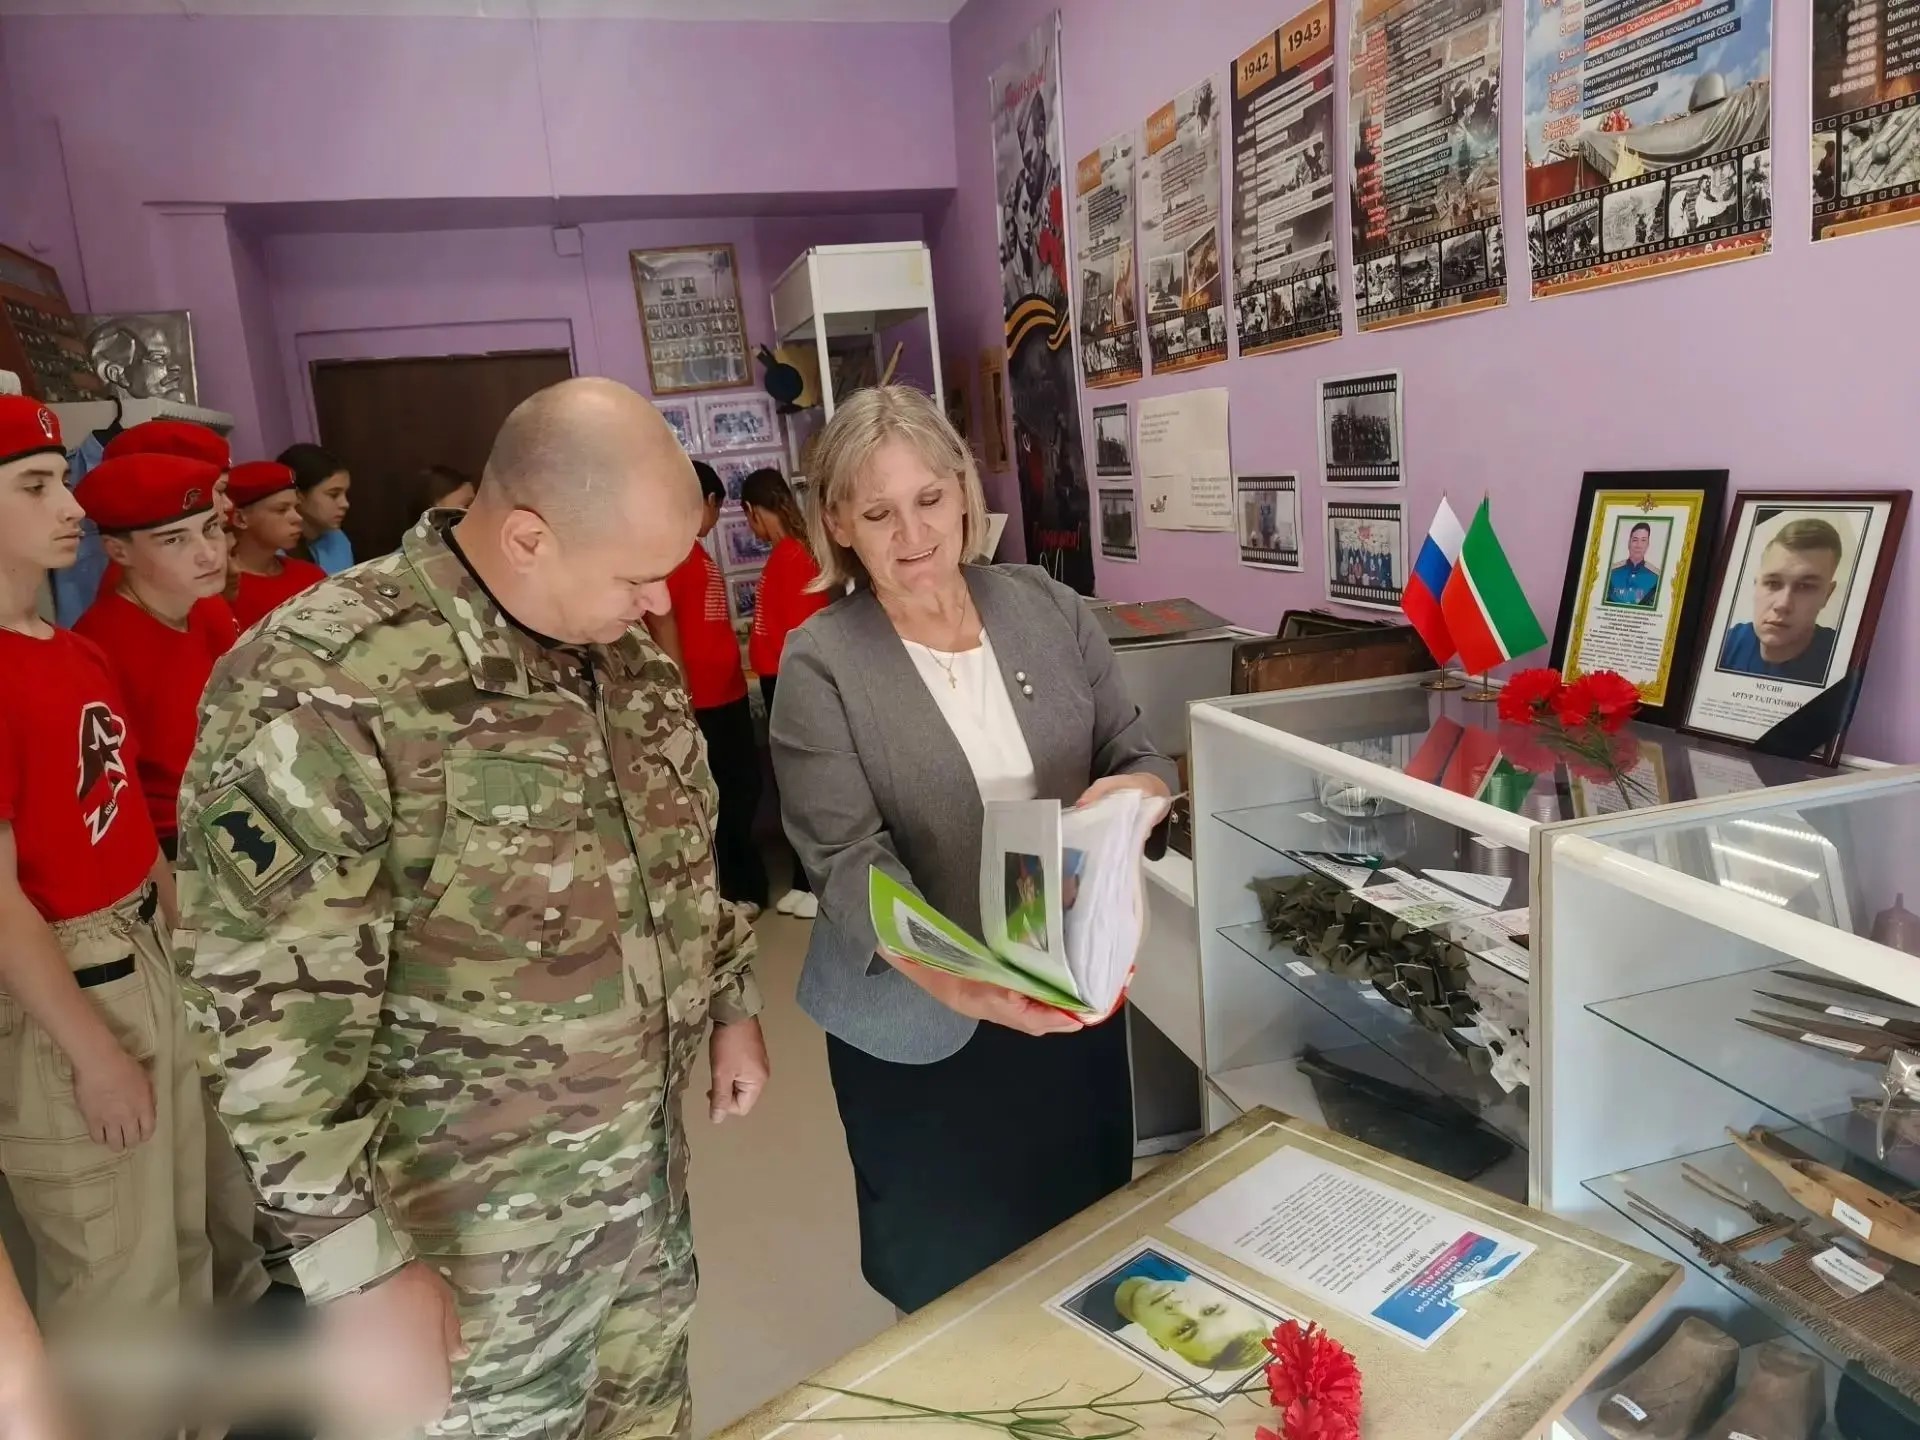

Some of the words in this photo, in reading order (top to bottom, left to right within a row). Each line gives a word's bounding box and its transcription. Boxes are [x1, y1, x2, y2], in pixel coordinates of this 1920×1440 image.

[1887, 22, 1910, 37] школ
[1888, 5, 1920, 22] библио
[1243, 52, 1268, 81] 1942
[1288, 18, 1321, 52] 1943
[1584, 53, 1602, 72] Парад
[1603, 42, 1628, 63] Победы
[1628, 42, 1636, 52] на
[1636, 27, 1665, 49] Красной
[1665, 16, 1694, 38] площади
[1700, 1, 1729, 22] Москве
[1583, 70, 1634, 100] Великобритании
[1639, 63, 1655, 79] США
[1661, 49, 1694, 72] Потсдаме
[1584, 65, 1619, 90] Берлинская
[1620, 49, 1663, 76] конференция
[1663, 27, 1716, 60] руководителей
[1886, 62, 1914, 80] людей
[1583, 102, 1601, 119] Война
[1601, 96, 1618, 112] СССР
[1732, 691, 1754, 701] АРТУР
[1754, 682, 1783, 693] МУСИН
[1405, 1254, 1459, 1297] ОПЕРАЦИИ
[1412, 1253, 1484, 1314] СПЕЦИАЛЬНОЙ
[1417, 1260, 1464, 1298] ВОЕННОЙ
